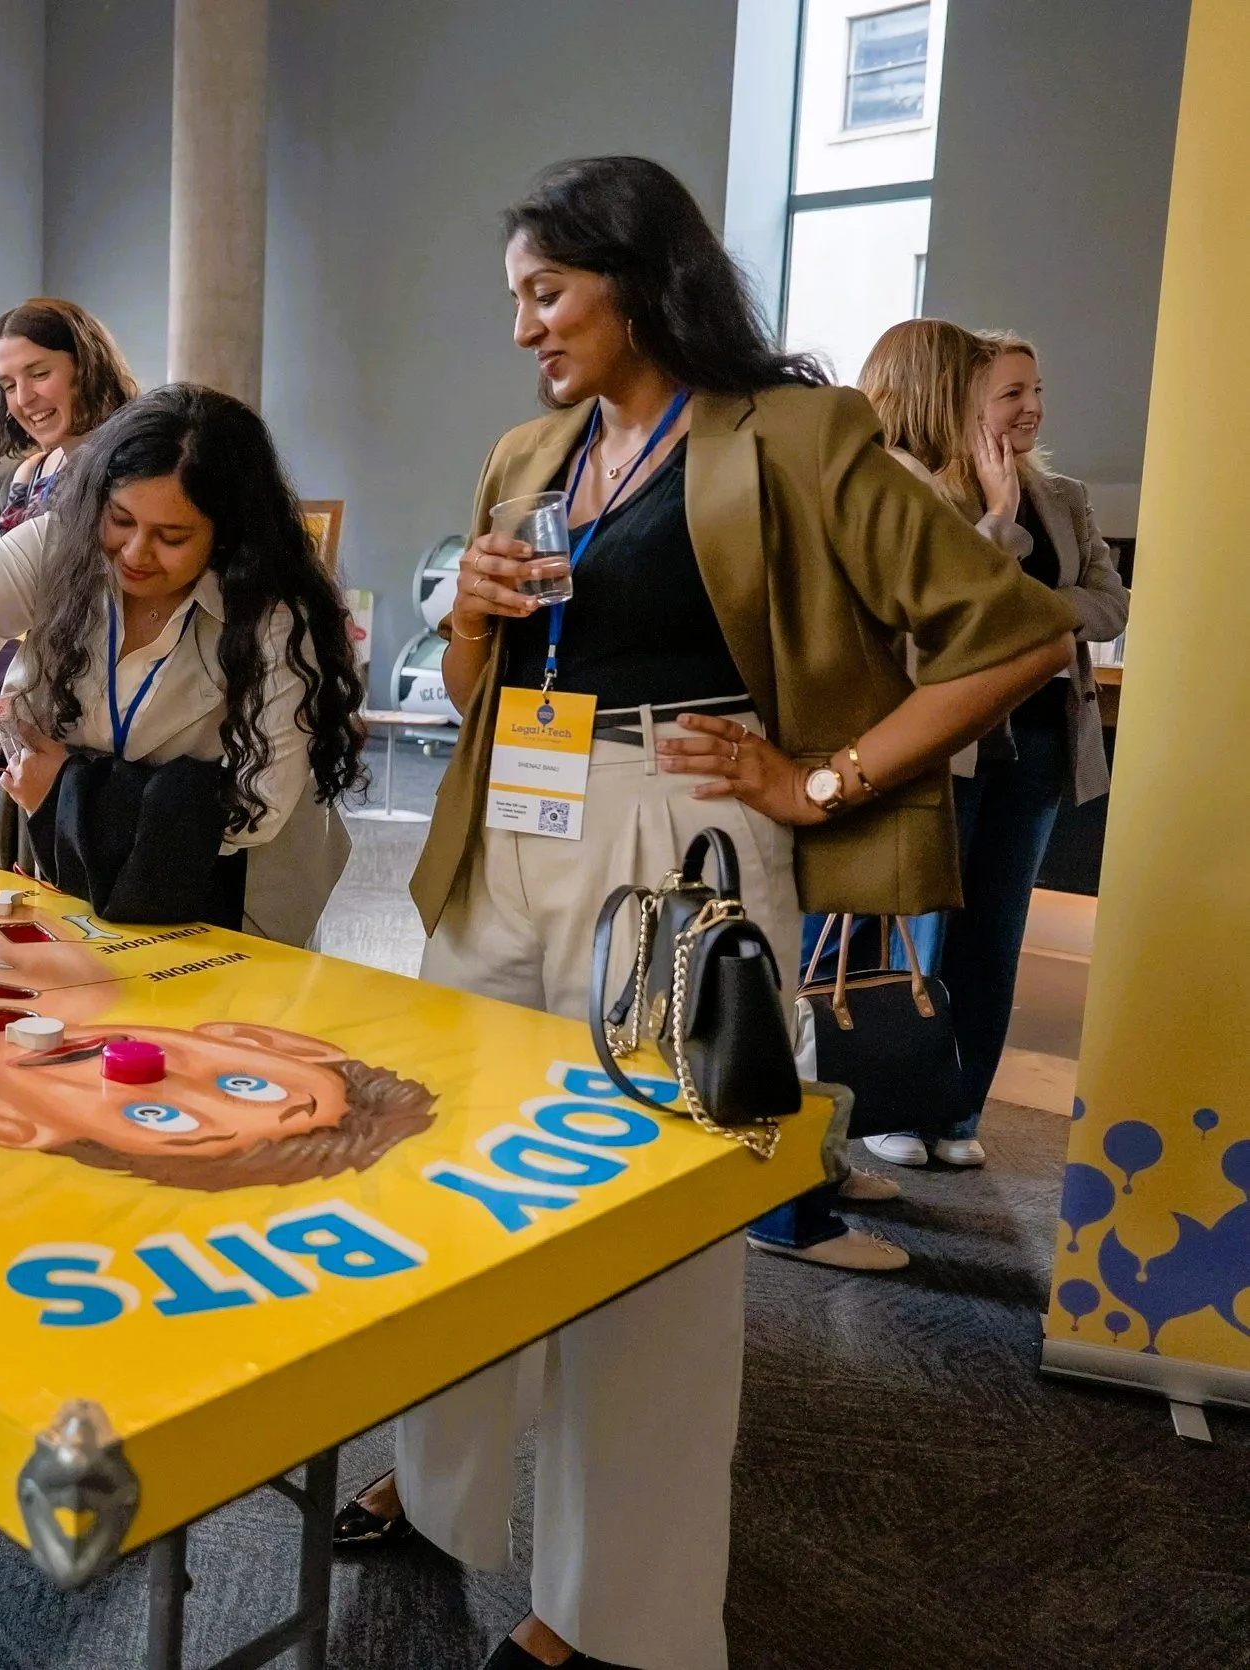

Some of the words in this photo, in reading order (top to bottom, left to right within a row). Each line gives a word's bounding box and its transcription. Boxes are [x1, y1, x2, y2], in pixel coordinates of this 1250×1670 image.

[511, 723, 540, 736] Legal
[548, 727, 572, 738] Tech
[96, 926, 211, 956] FUNNYBONE
[143, 952, 252, 982] WISHBONE
[424, 1062, 682, 1235] BODY
[6, 1204, 426, 1328] BITS
